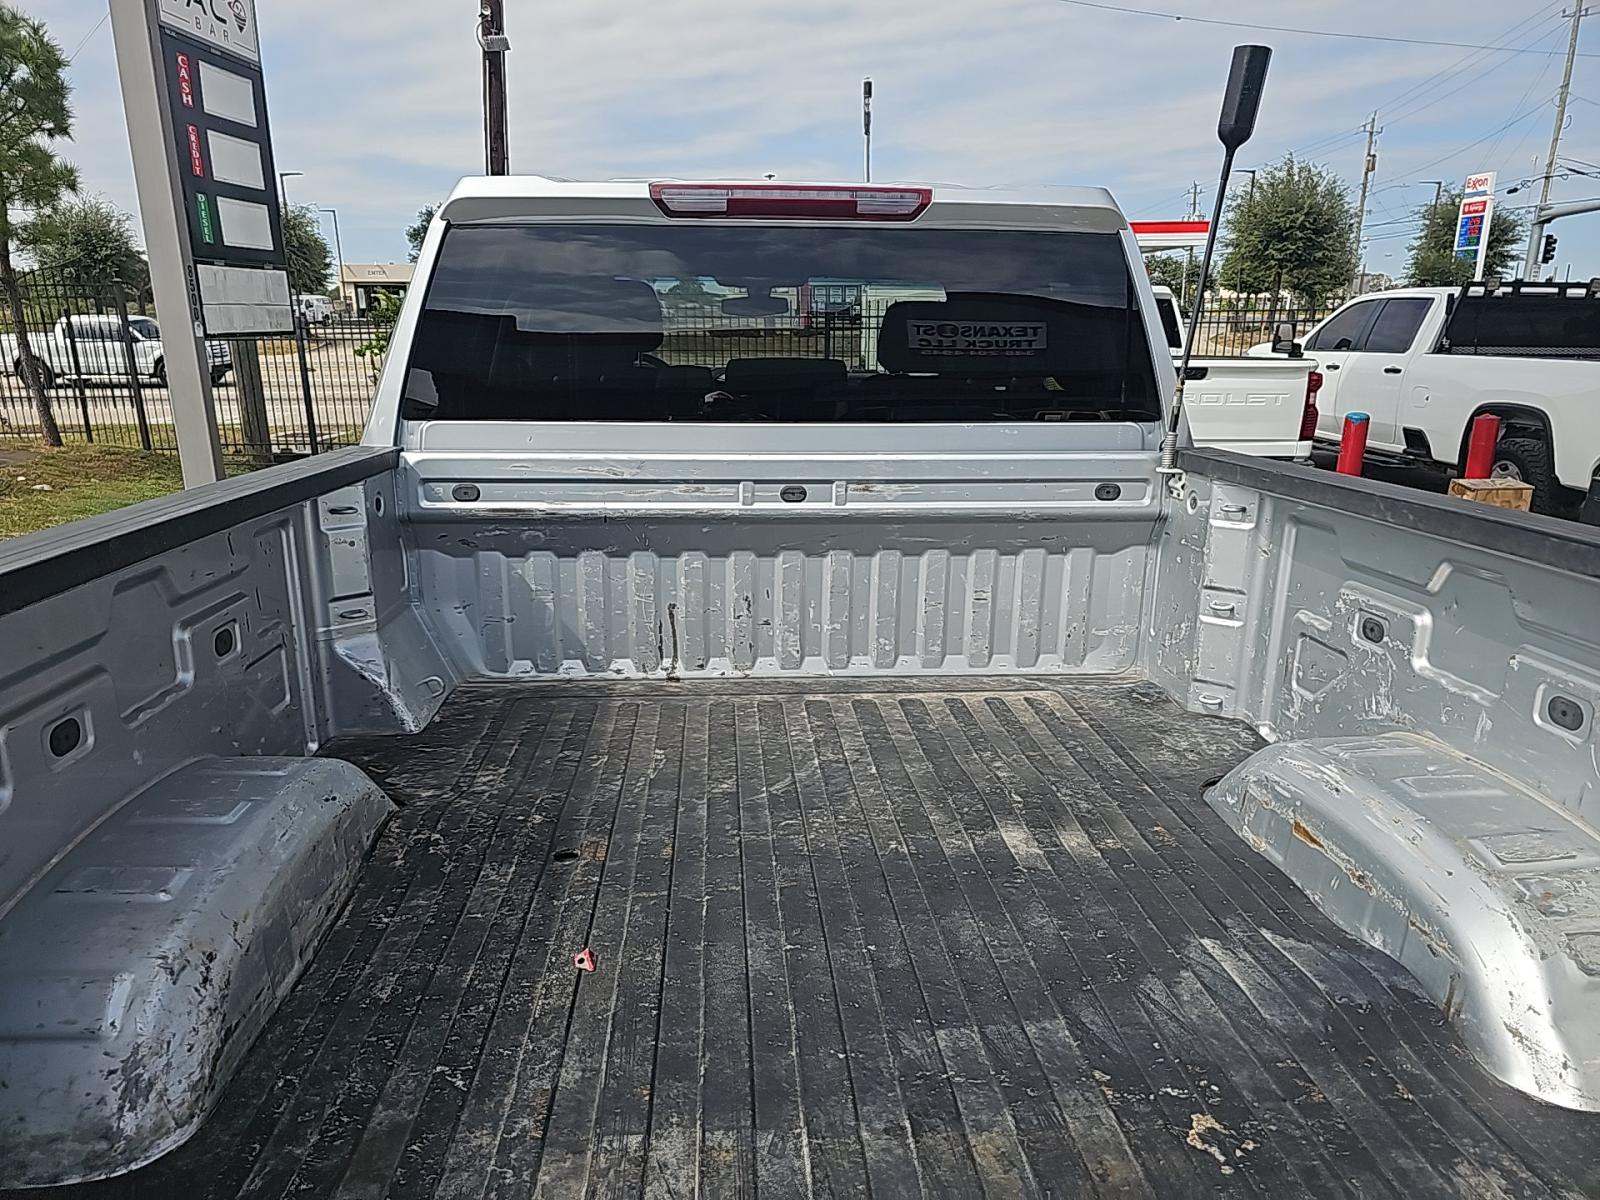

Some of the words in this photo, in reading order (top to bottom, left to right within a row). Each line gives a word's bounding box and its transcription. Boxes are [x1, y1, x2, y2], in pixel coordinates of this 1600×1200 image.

[194, 16, 230, 42] BAR
[177, 55, 193, 106] CASH
[187, 125, 202, 176] CREDIT
[1467, 178, 1488, 191] Exxon
[197, 192, 212, 243] DIESEL
[1184, 392, 1290, 406] ROLET
